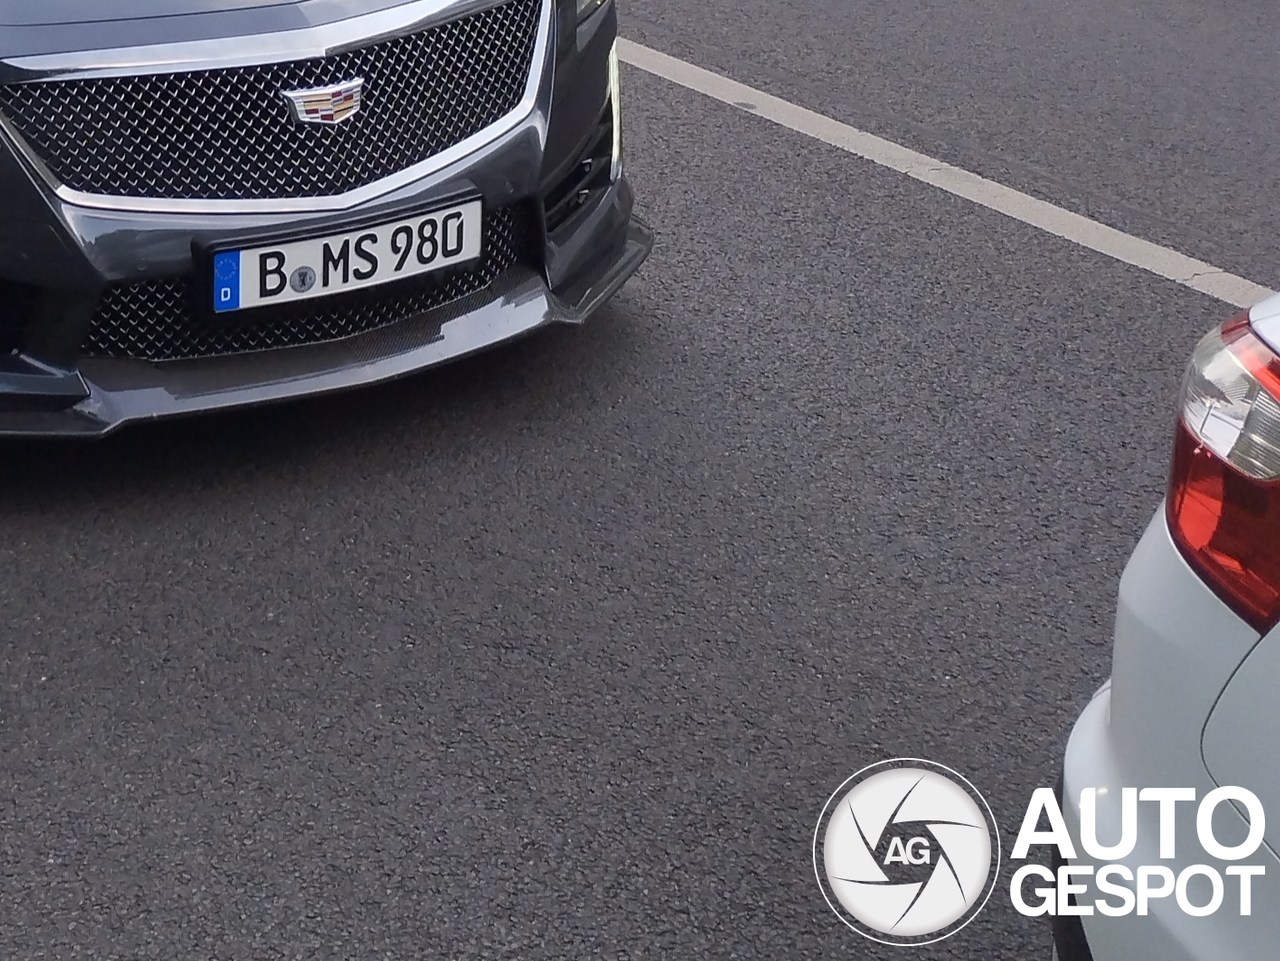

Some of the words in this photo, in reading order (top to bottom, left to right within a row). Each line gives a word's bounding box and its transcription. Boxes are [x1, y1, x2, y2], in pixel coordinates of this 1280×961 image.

[259, 251, 288, 299] B
[322, 234, 379, 288] MS
[391, 212, 464, 272] 980
[221, 287, 231, 302] D
